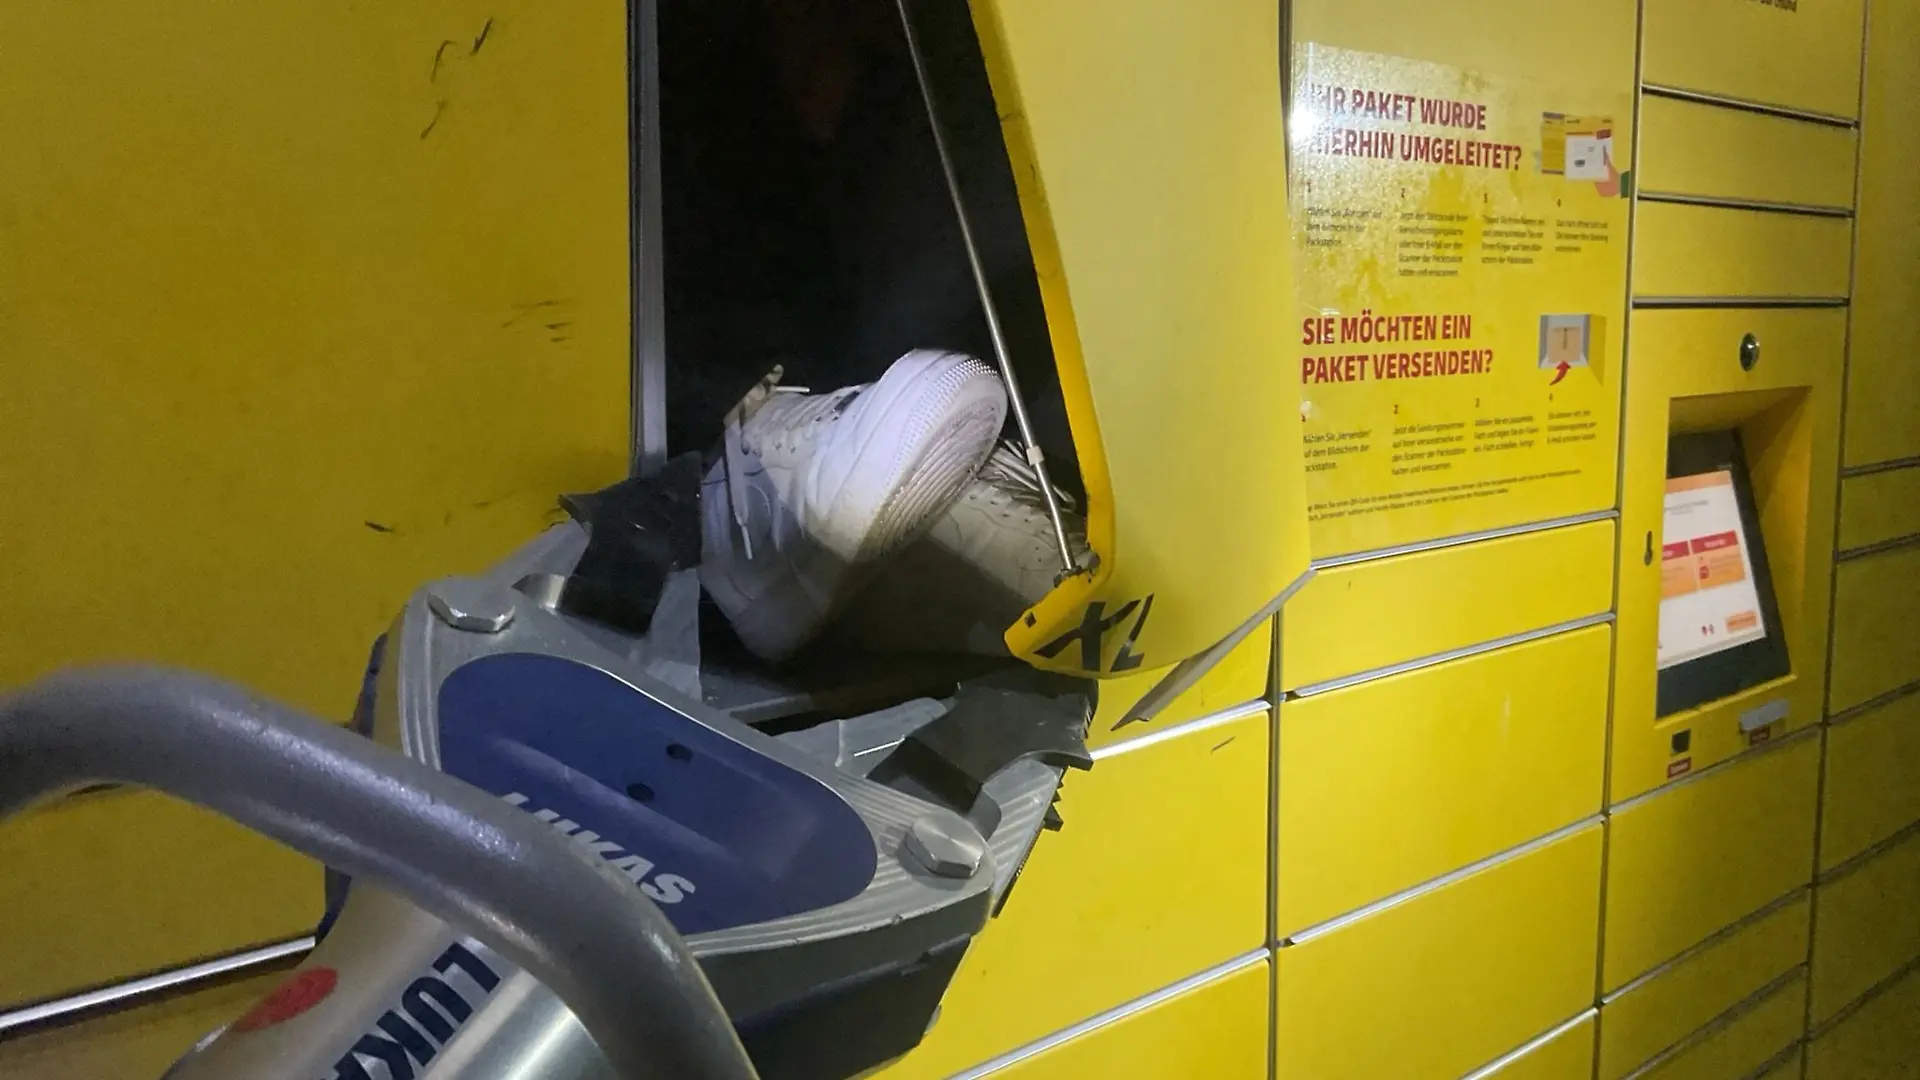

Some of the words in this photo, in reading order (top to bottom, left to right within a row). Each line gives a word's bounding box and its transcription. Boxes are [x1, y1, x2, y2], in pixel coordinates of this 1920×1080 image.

[1352, 89, 1415, 123] PAKET
[1420, 97, 1486, 130] WURDE
[1400, 133, 1522, 170] UMGELEITET?
[1303, 313, 1334, 345] SIE
[1341, 309, 1436, 343] MÖCHTEN
[1441, 314, 1471, 339] EIN
[1302, 354, 1369, 384] PAKET
[1373, 349, 1493, 380] VERSENDEN?
[1033, 592, 1155, 673] XL
